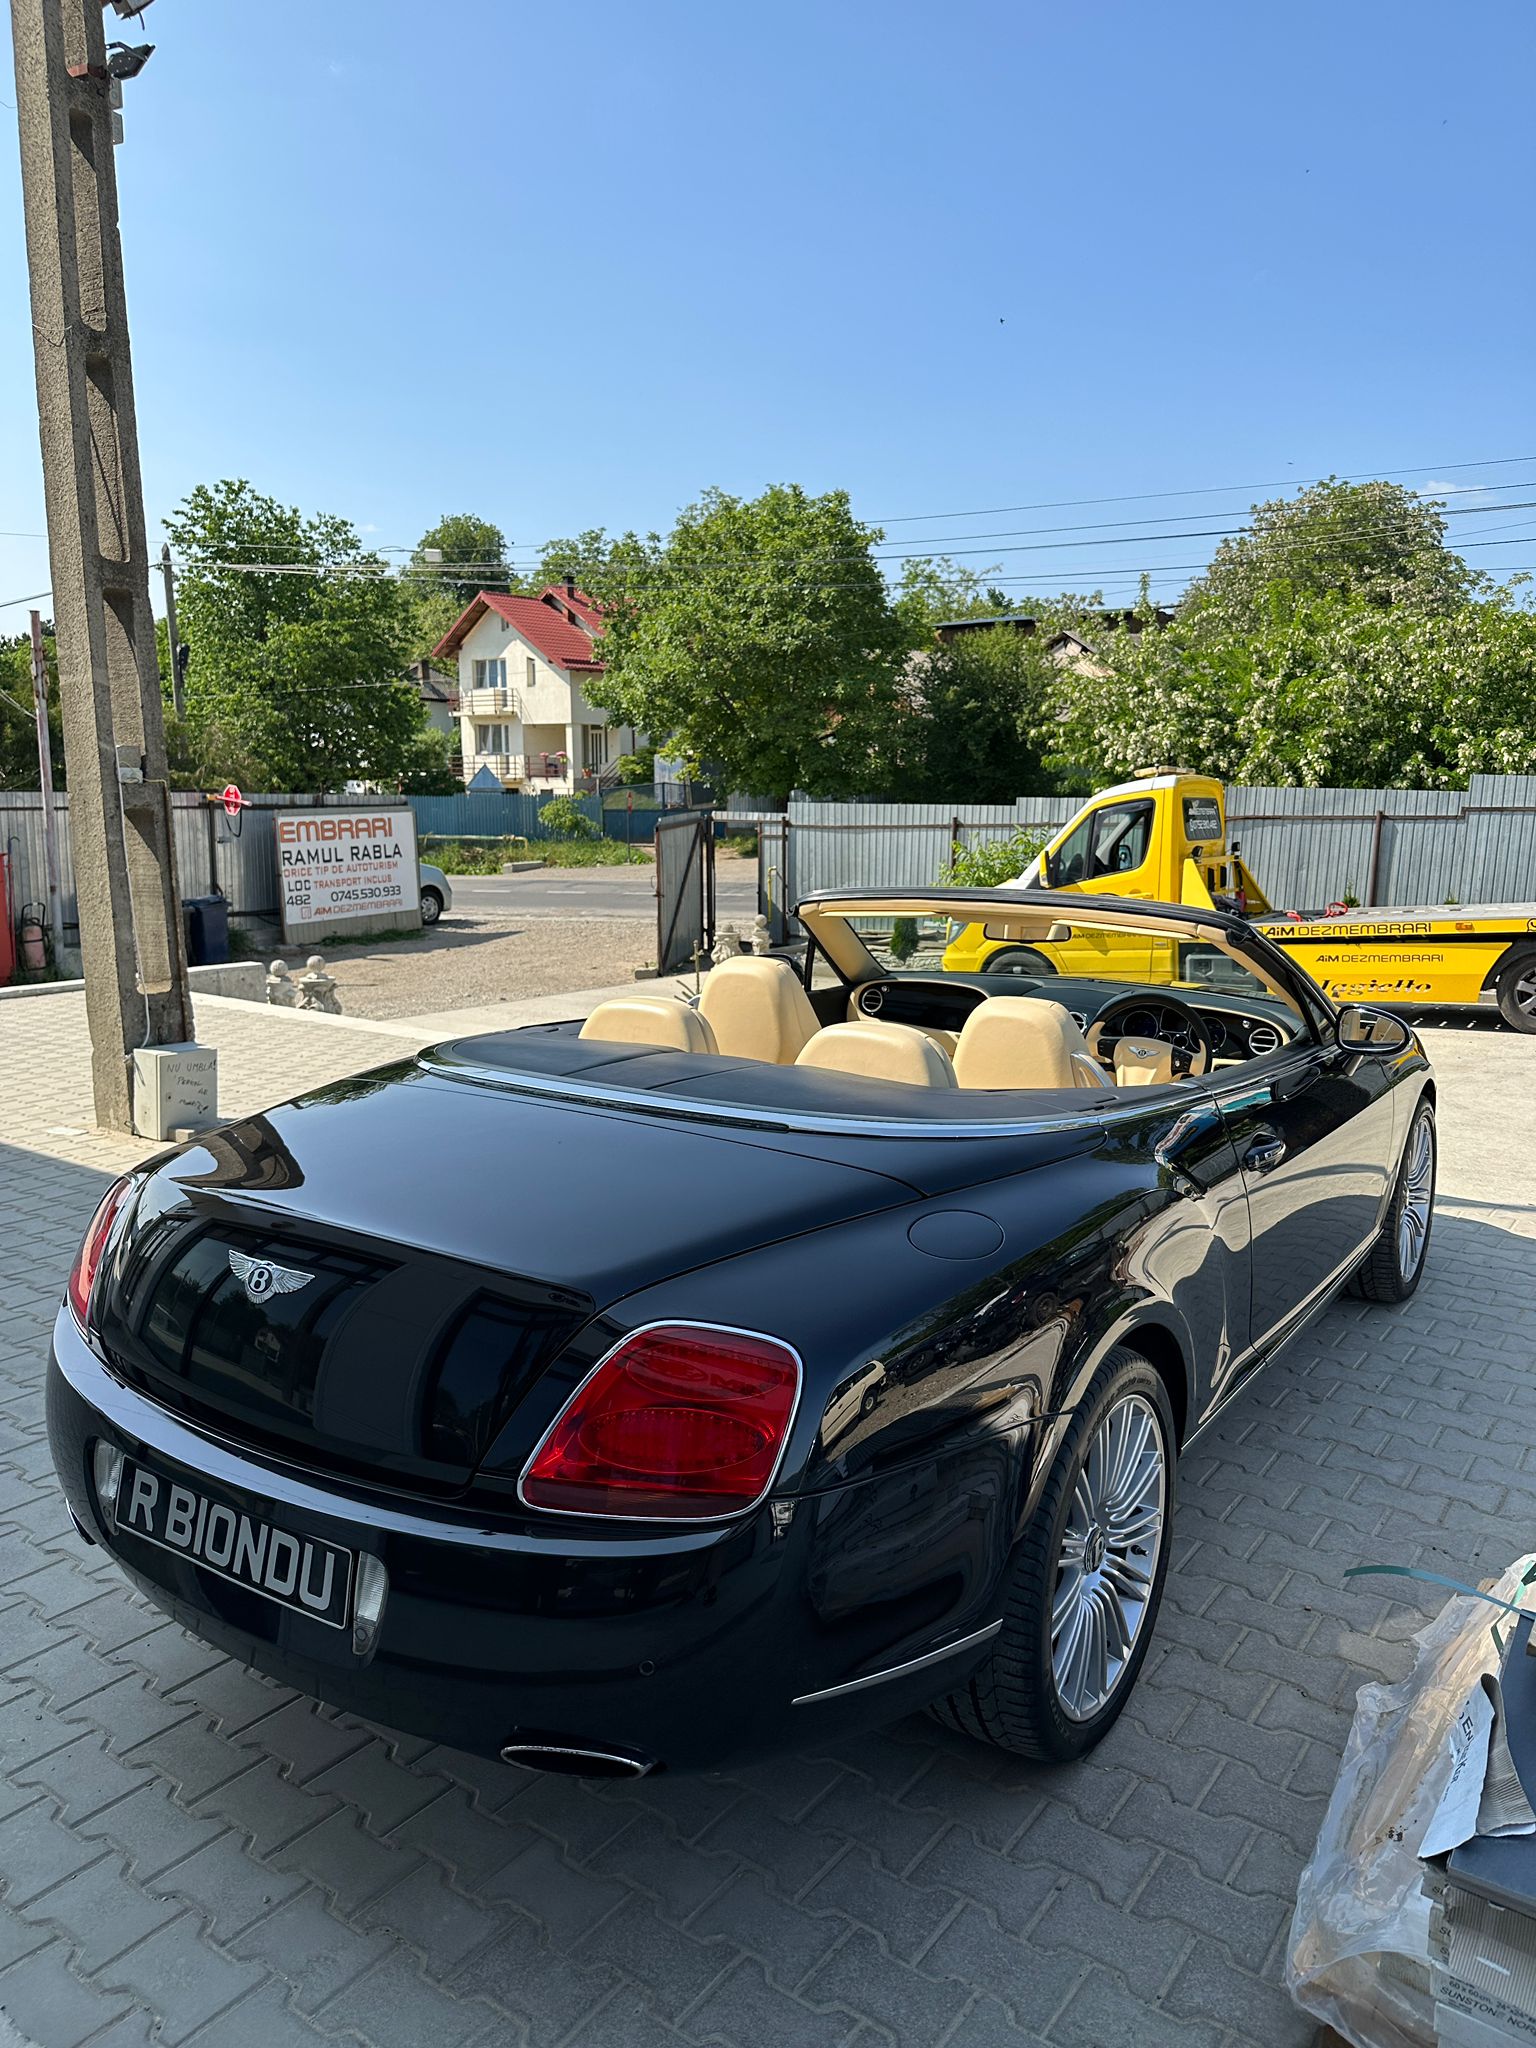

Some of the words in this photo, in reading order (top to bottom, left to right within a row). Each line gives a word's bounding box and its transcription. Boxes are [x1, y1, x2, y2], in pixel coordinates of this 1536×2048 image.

[279, 817, 393, 843] EMBRARI
[282, 847, 344, 867] RAMUL
[350, 843, 403, 861] RABLA
[283, 867, 313, 878] ORICE
[315, 865, 329, 876] TIP
[332, 864, 344, 874] DE
[346, 861, 399, 873] AUTOTURISM
[288, 879, 312, 892] LOC
[314, 877, 361, 889] TRANSPORT
[364, 874, 393, 884] INCLUS
[287, 894, 312, 906] 482
[333, 899, 403, 914] DEZMEMBRARI
[1298, 922, 1432, 936] DEZMEMBRARI
[1341, 954, 1444, 963] DEZMEMBRARI
[128, 1468, 159, 1532] R
[164, 1483, 335, 1612] BIONDU
